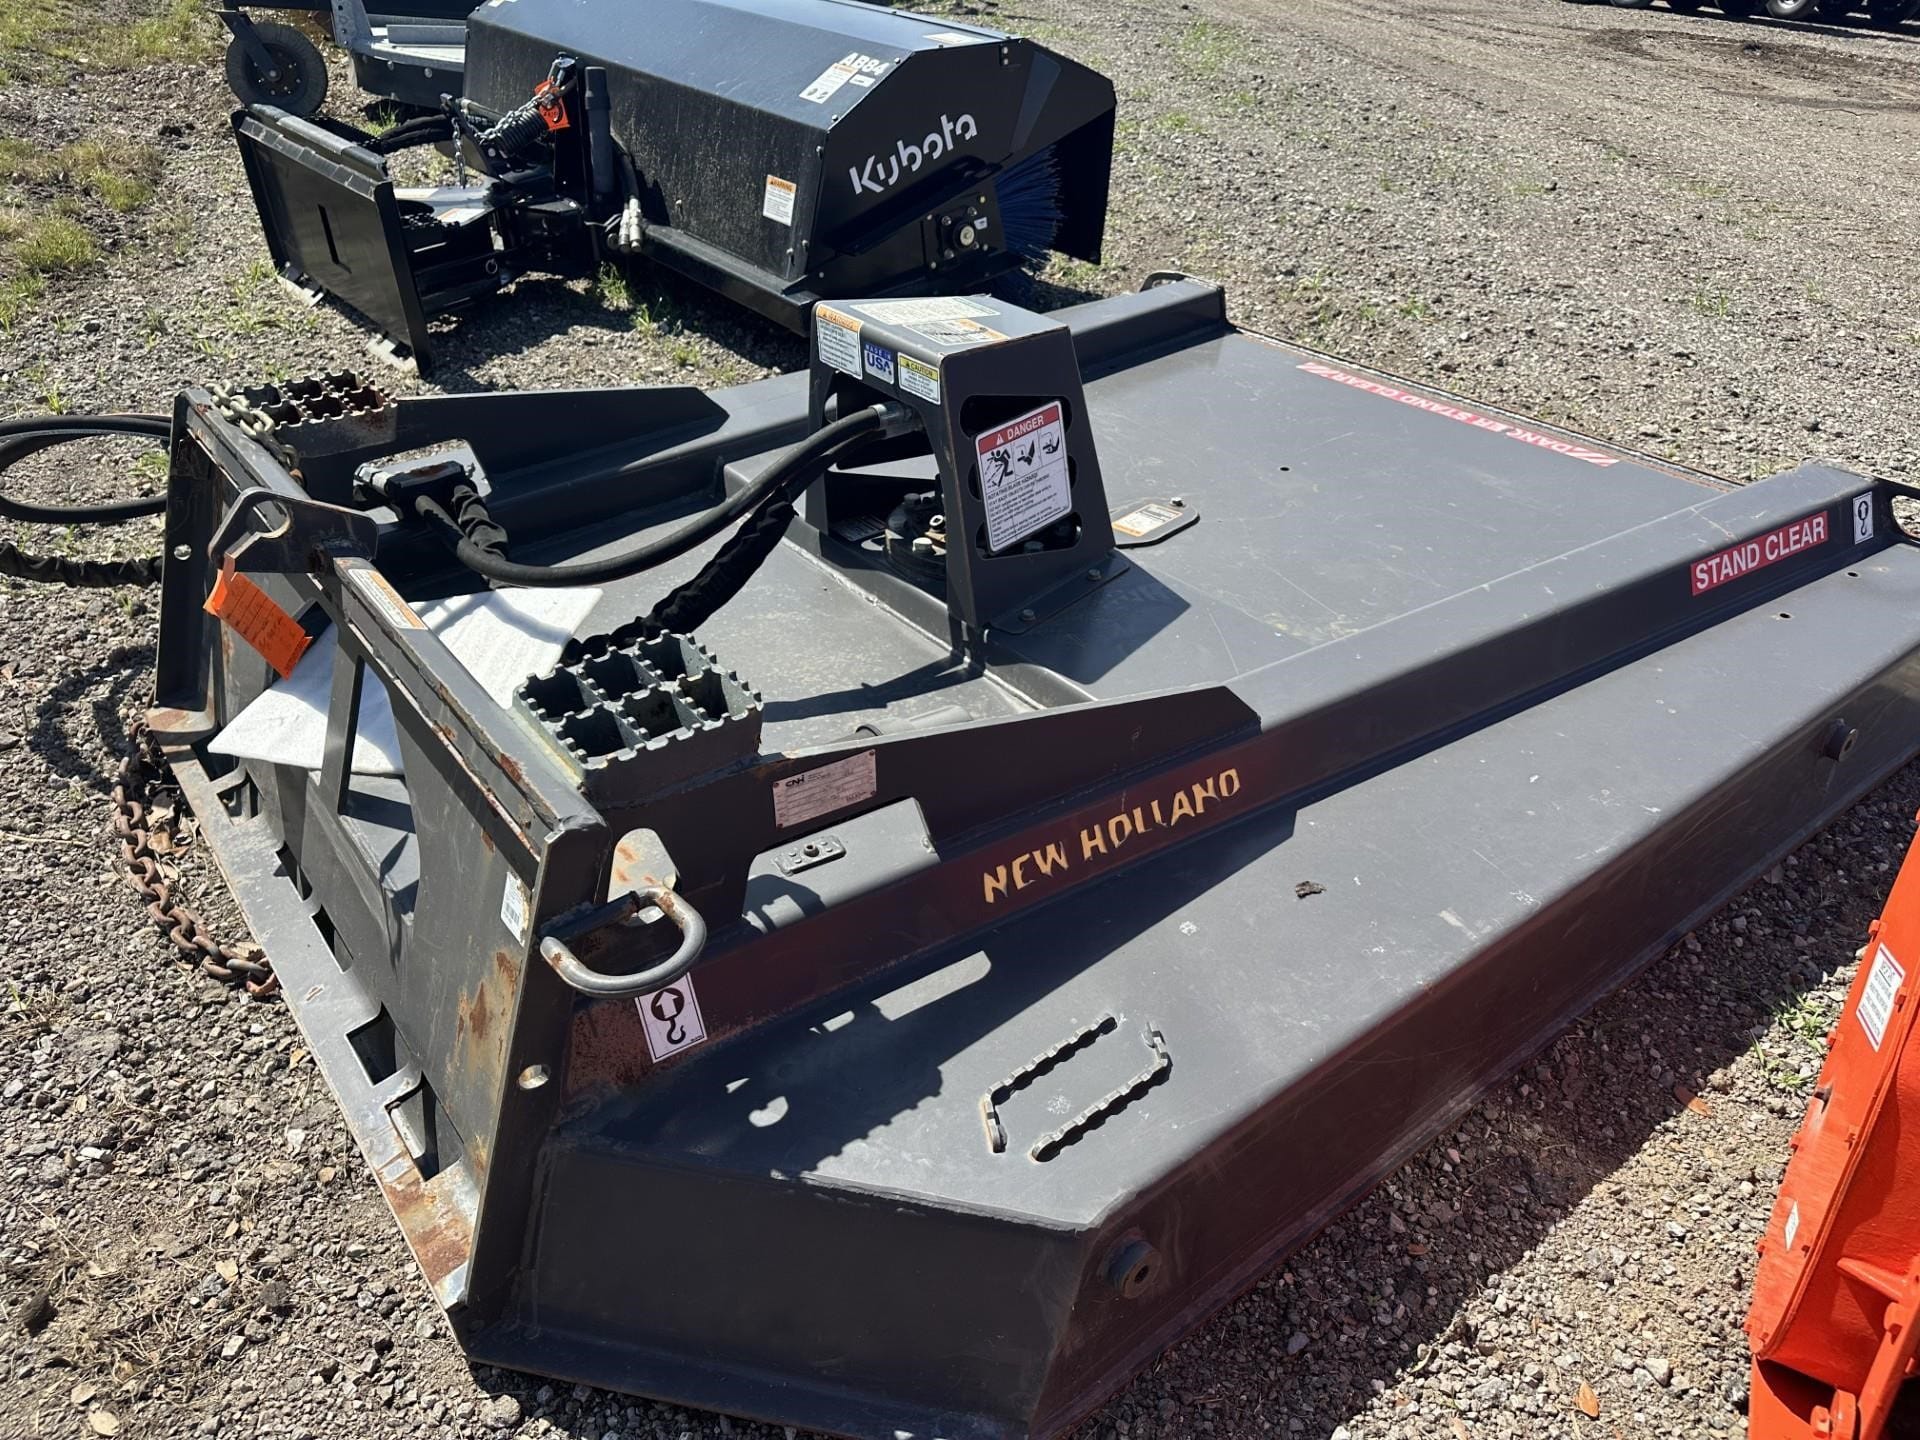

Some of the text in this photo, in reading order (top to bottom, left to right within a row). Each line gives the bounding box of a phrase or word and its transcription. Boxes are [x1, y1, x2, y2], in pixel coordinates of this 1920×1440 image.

[838, 52, 890, 76] AB84
[849, 113, 978, 195] Kubota
[866, 352, 892, 376] USA
[910, 361, 934, 377] CAUTION
[1400, 394, 1474, 421] STAND
[1007, 415, 1045, 440] DANGER
[1696, 516, 1826, 590] STAND CLEAR
[983, 768, 1241, 904] NEW HOLLAND
